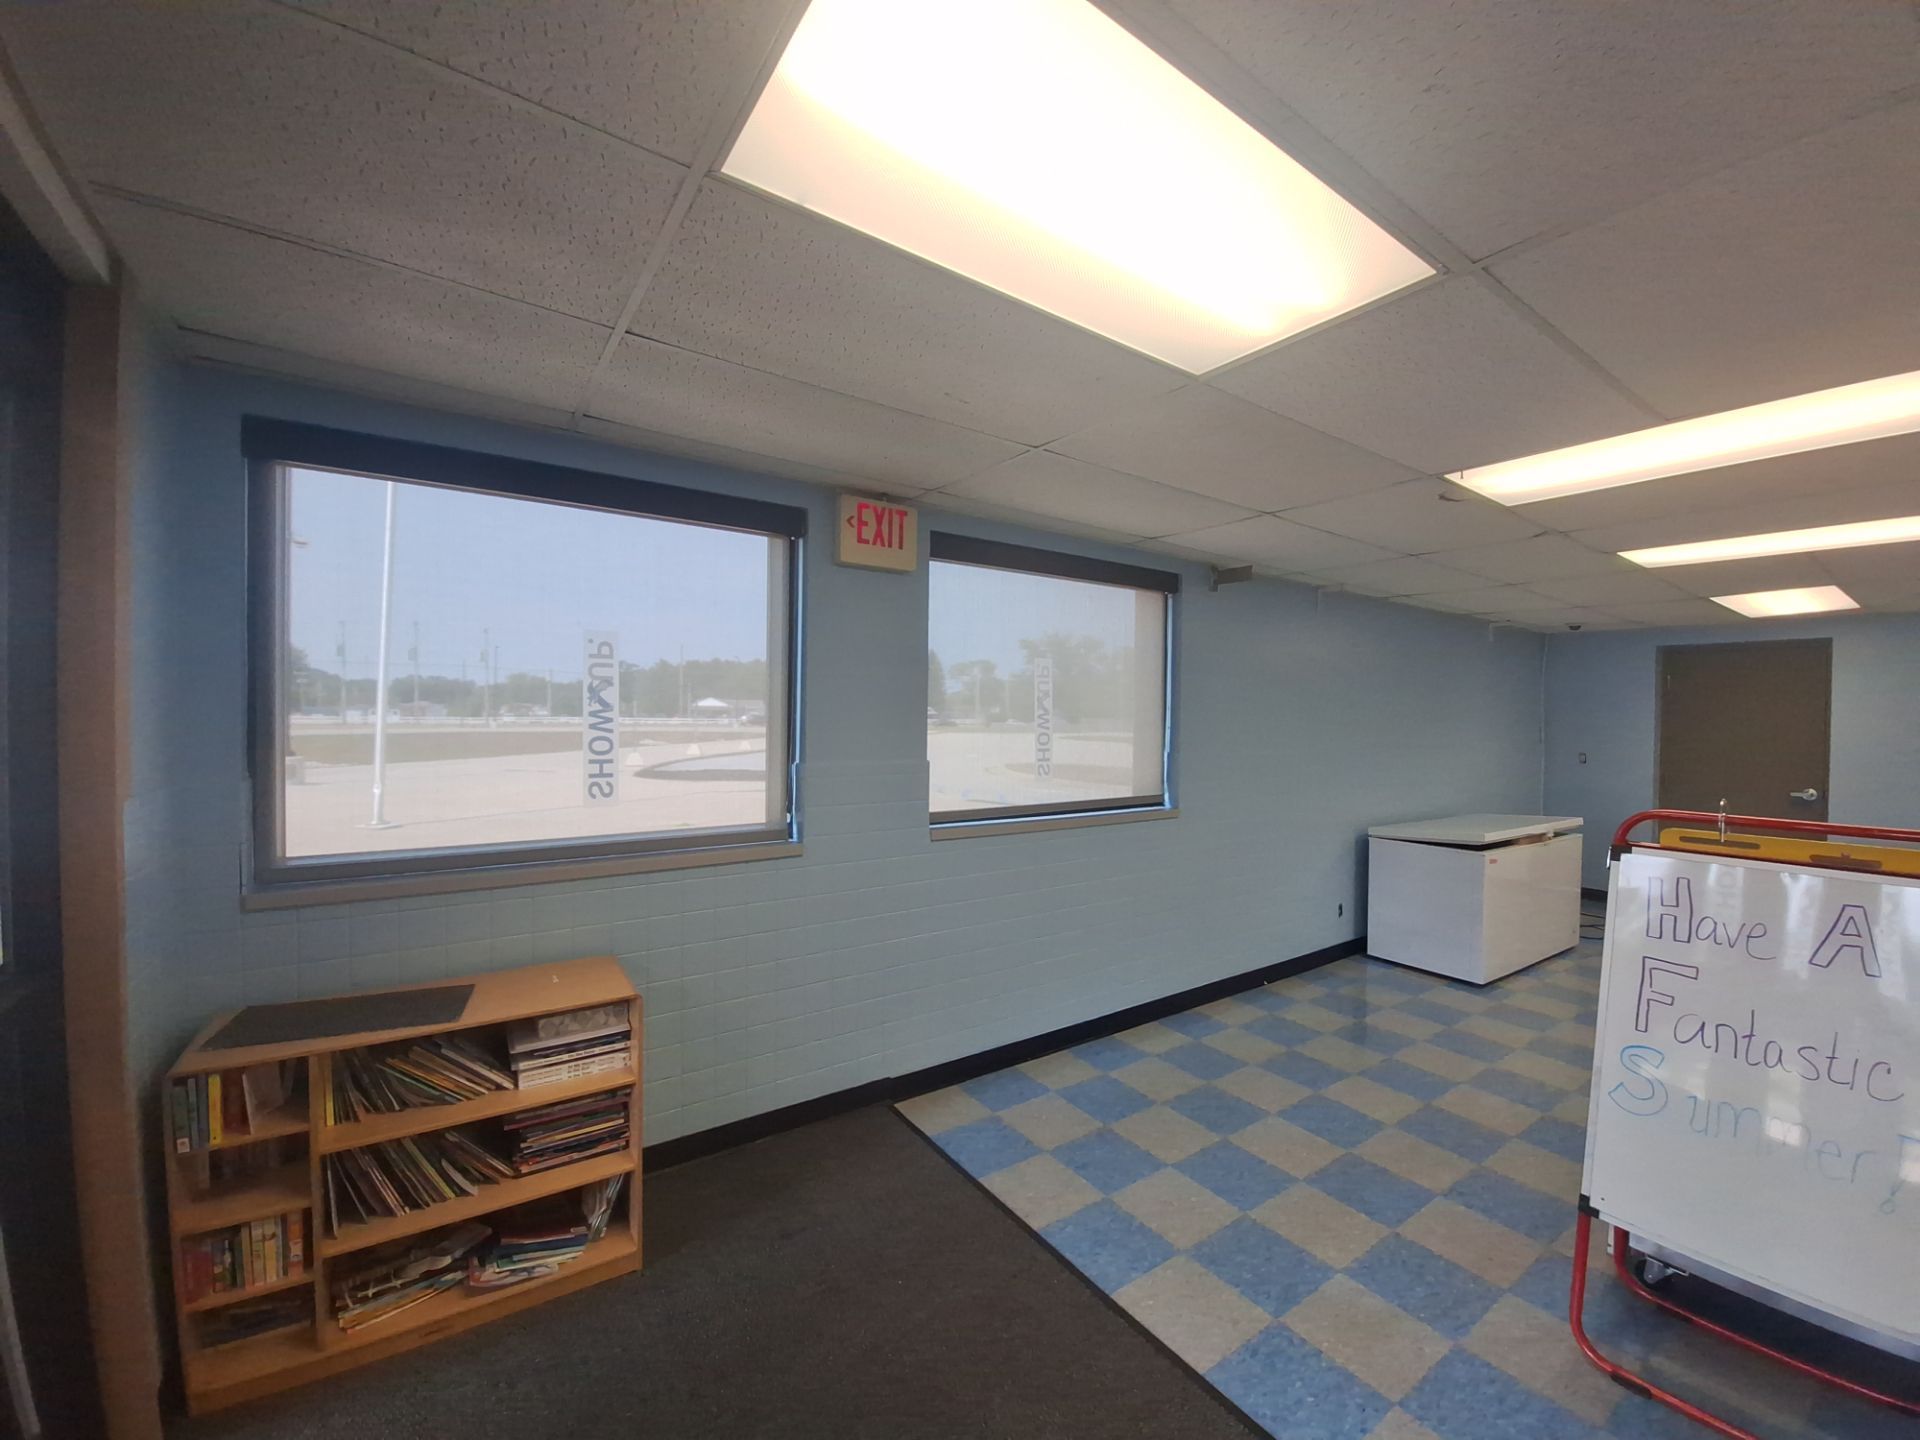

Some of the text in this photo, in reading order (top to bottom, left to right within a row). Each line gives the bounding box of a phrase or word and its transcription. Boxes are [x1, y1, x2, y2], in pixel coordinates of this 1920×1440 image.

[856, 502, 908, 549] EXIT
[1645, 876, 1777, 960] Have
[1808, 904, 1882, 978] A
[1634, 956, 1905, 1103] Fantastic
